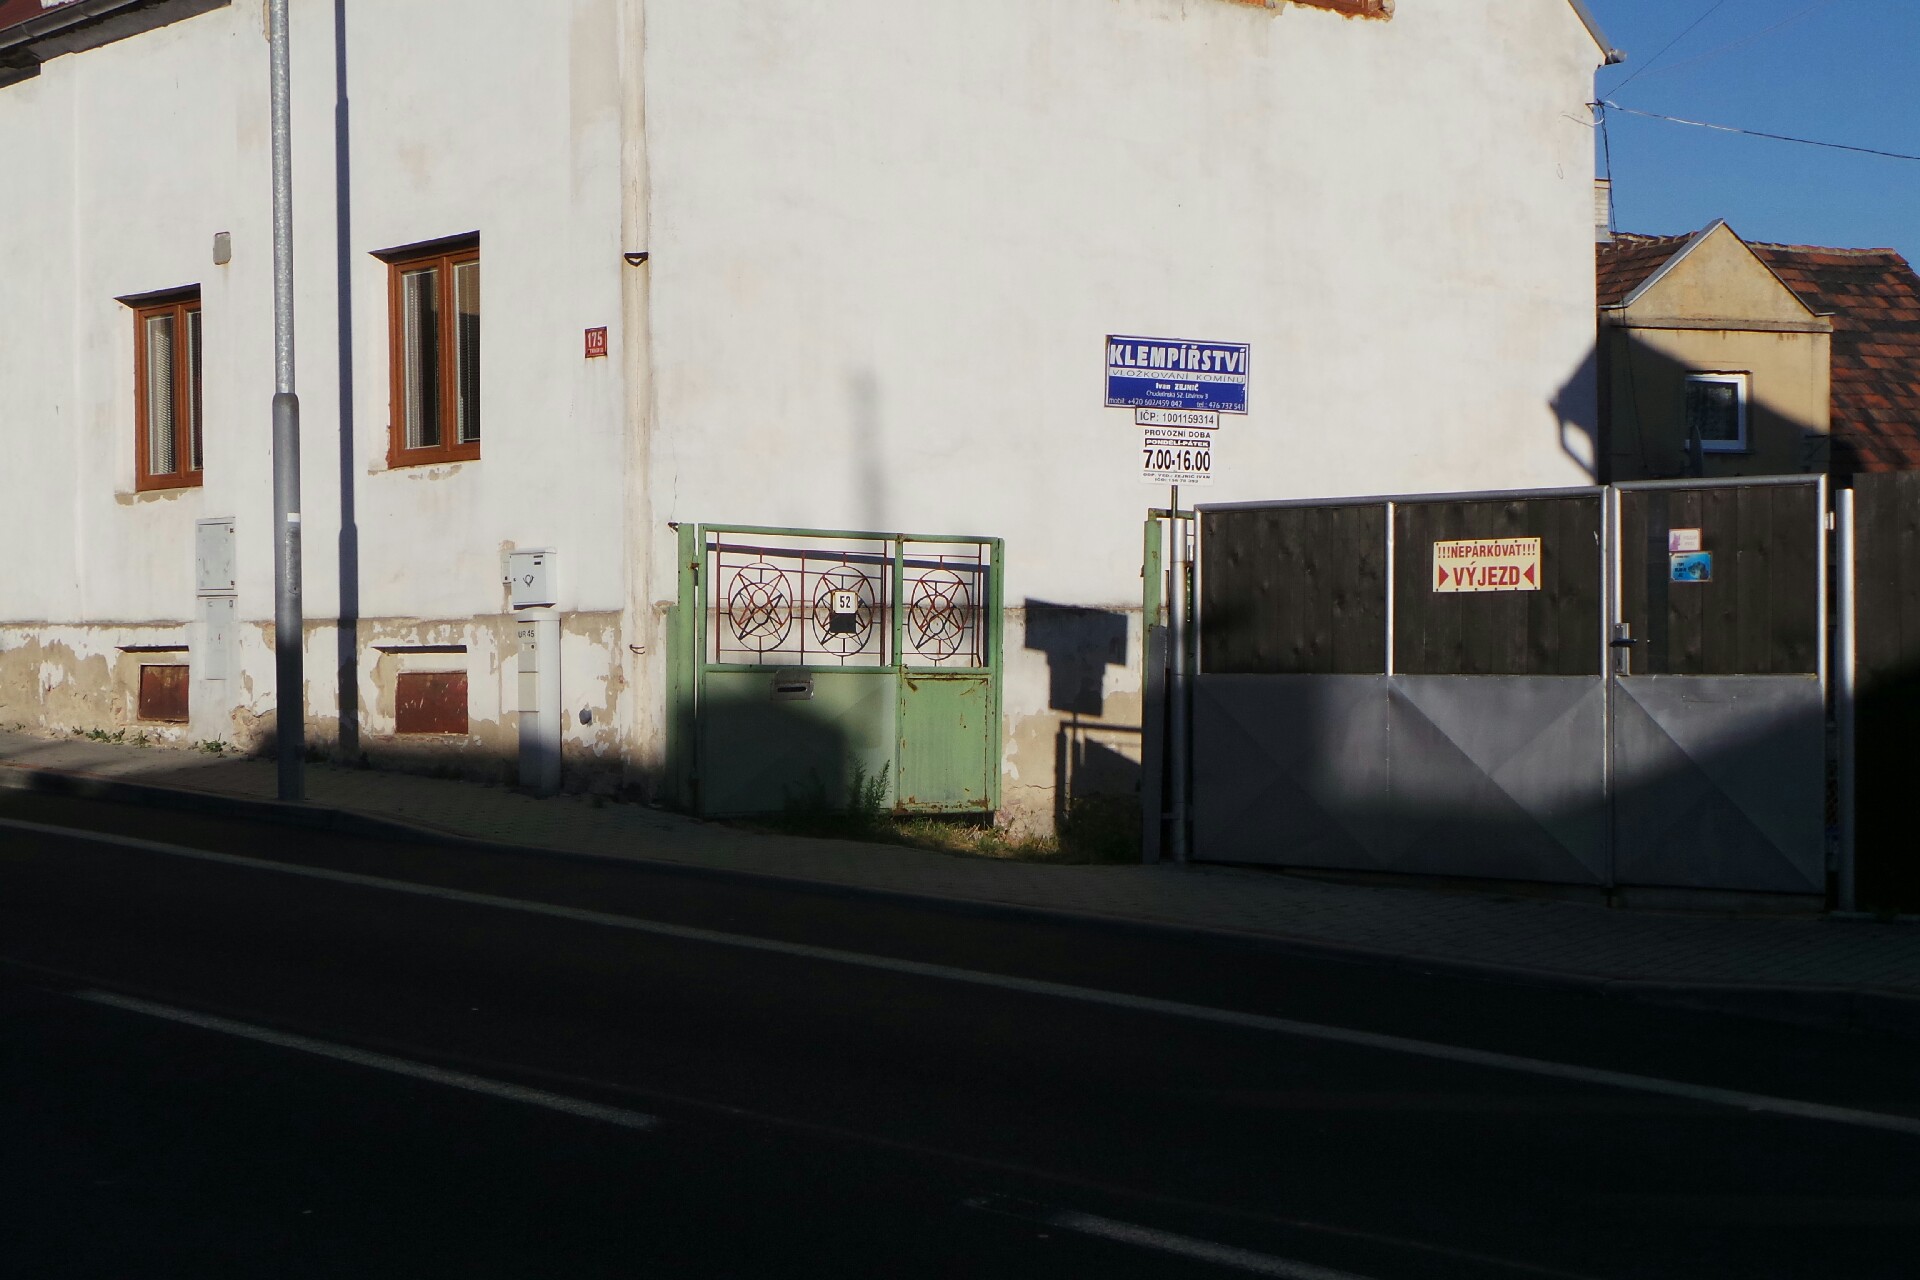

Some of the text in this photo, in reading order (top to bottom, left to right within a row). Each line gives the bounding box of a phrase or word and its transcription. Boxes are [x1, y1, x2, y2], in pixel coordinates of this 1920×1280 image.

[587, 331, 603, 348] 175
[1109, 344, 1246, 373] KLEMPÍŘSTVÍ
[1155, 382, 1171, 390] Ivan
[1127, 397, 1144, 406] +420
[1221, 402, 1233, 410] 732
[1233, 403, 1244, 411] 541
[1140, 409, 1214, 424] IČP: 1001159314
[1188, 431, 1211, 439] DOBA
[1143, 449, 1211, 472] 7.00-16.00
[1438, 543, 1536, 559] !!!NEPARKOVAT!!!
[1453, 560, 1521, 587] VÝJEZD
[839, 595, 851, 609] 52
